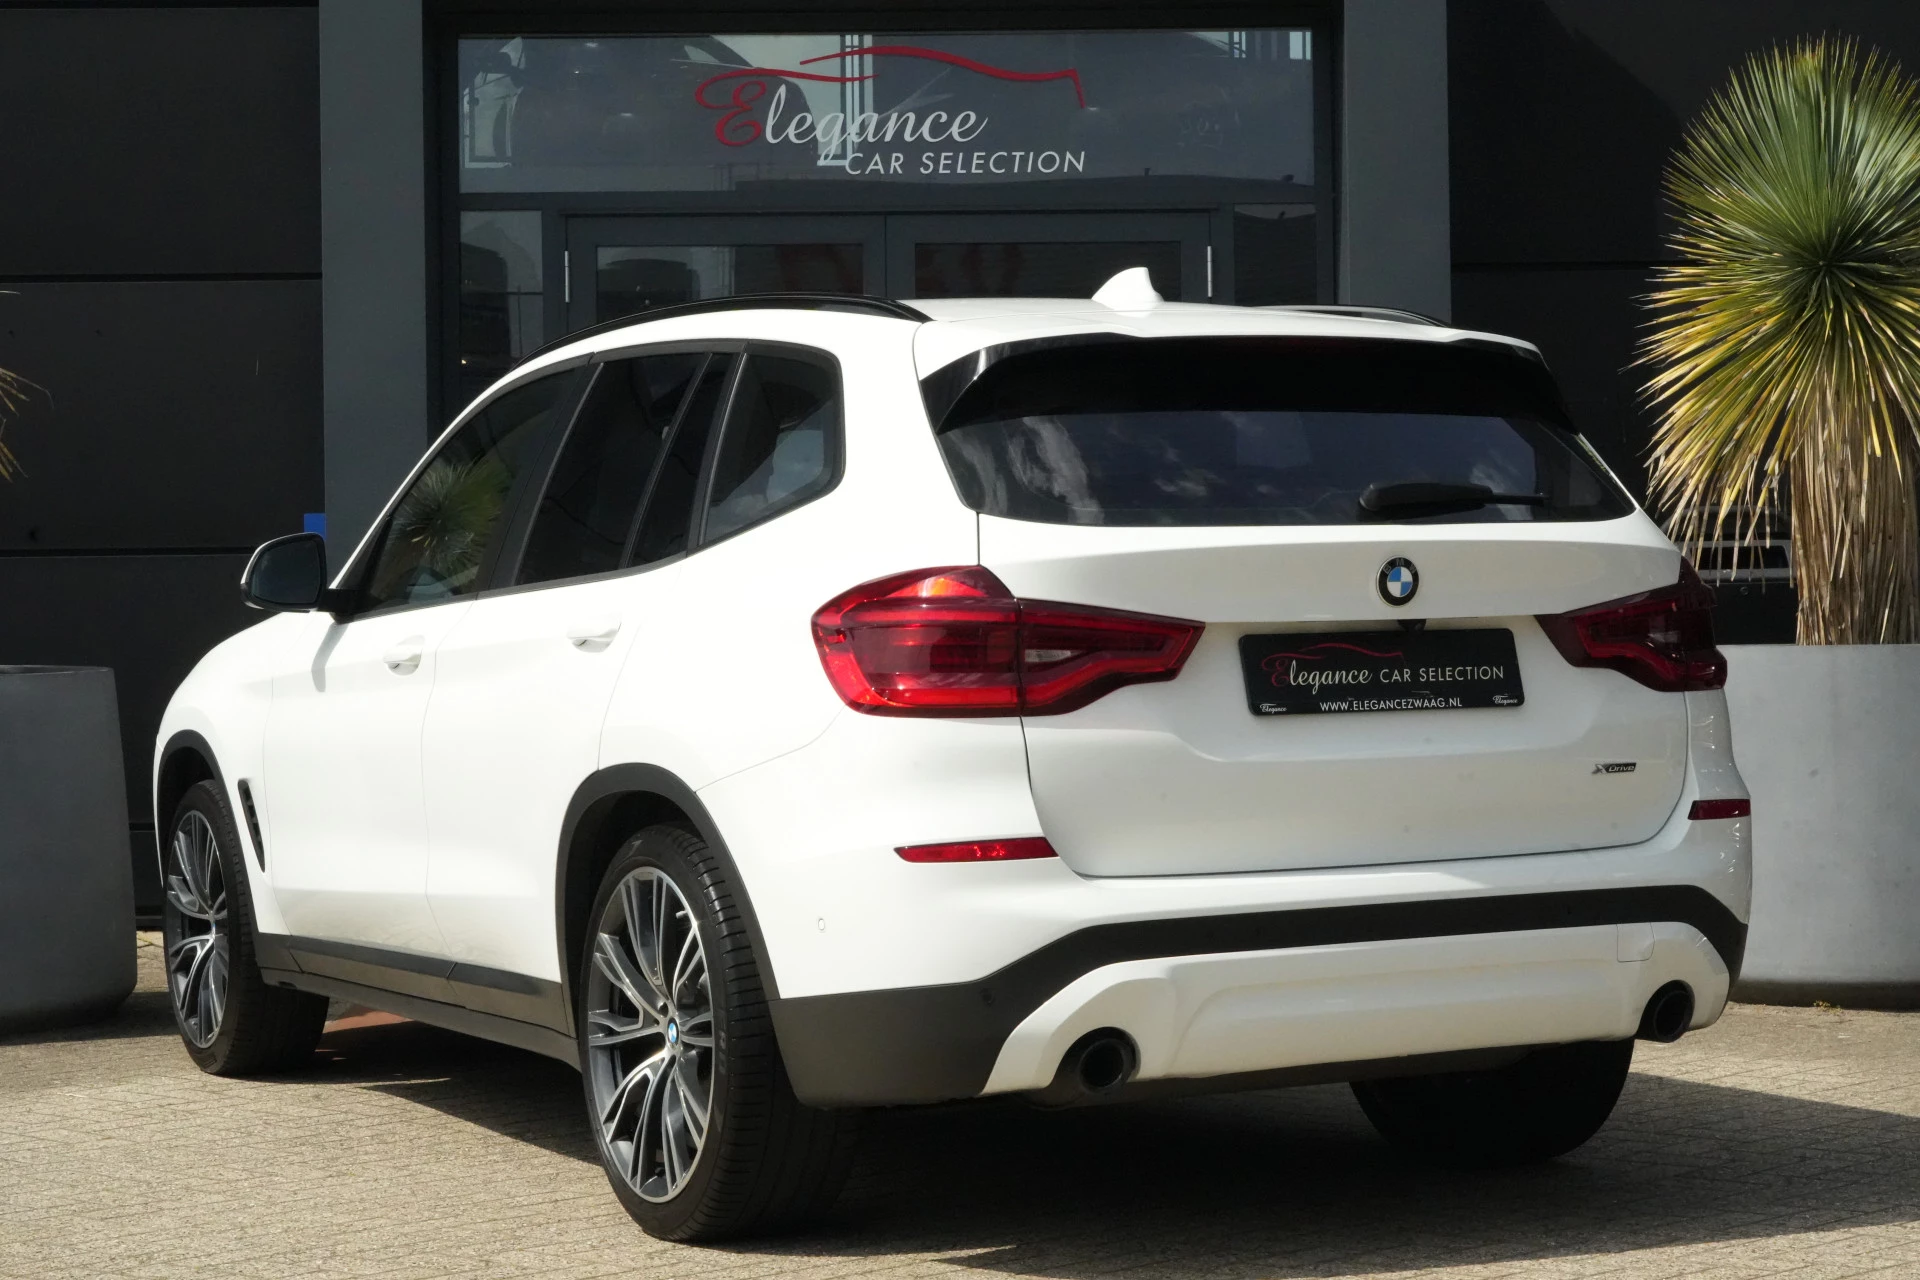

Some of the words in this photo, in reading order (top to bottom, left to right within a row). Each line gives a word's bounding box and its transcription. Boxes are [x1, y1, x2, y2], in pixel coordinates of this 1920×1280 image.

[696, 70, 988, 165] Elegance
[845, 152, 904, 175] CAR
[919, 151, 1085, 174] SELECTION
[1262, 653, 1373, 695] Elegance
[1380, 668, 1412, 683] CAR
[1419, 665, 1504, 682] SELECTION
[1320, 697, 1463, 712] WWW.ELEGANCEZWAAG.NL
